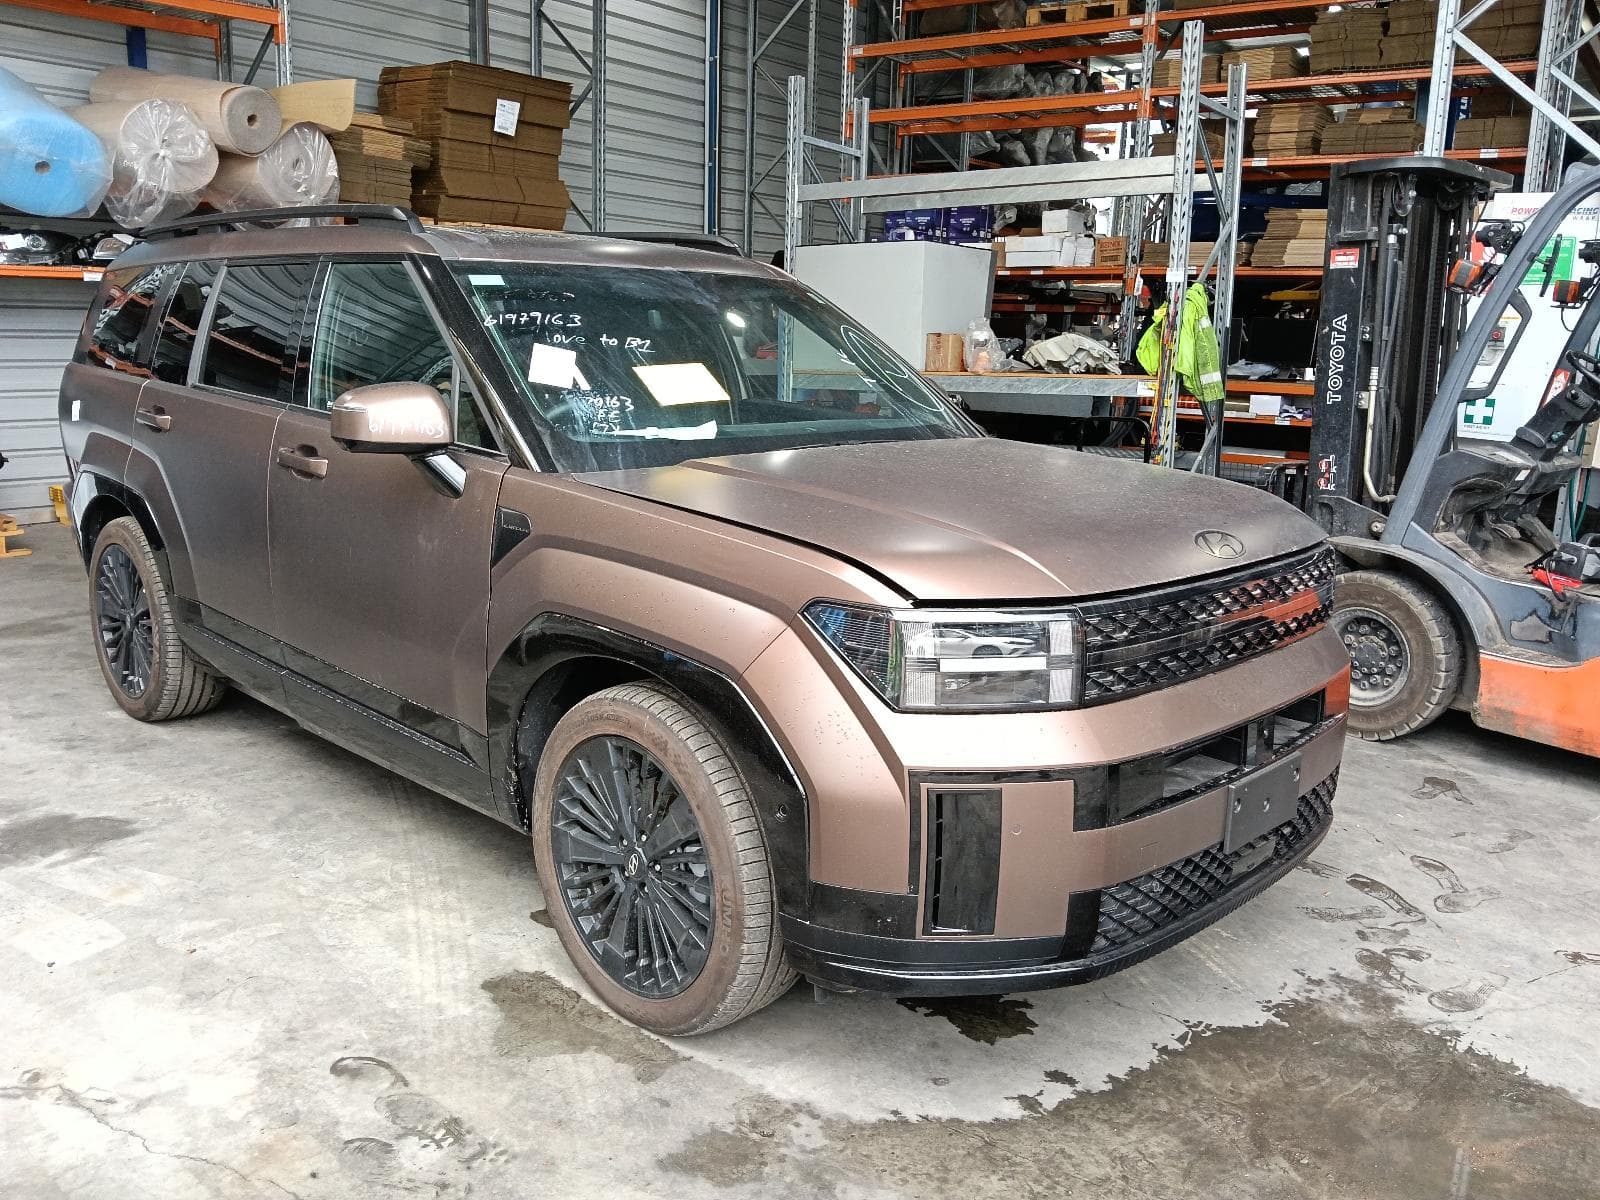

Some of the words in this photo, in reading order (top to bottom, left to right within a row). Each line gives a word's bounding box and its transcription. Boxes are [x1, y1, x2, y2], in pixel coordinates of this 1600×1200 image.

[483, 311, 582, 327] 61979163
[600, 333, 619, 348] to
[1326, 313, 1348, 405] TOYOTA
